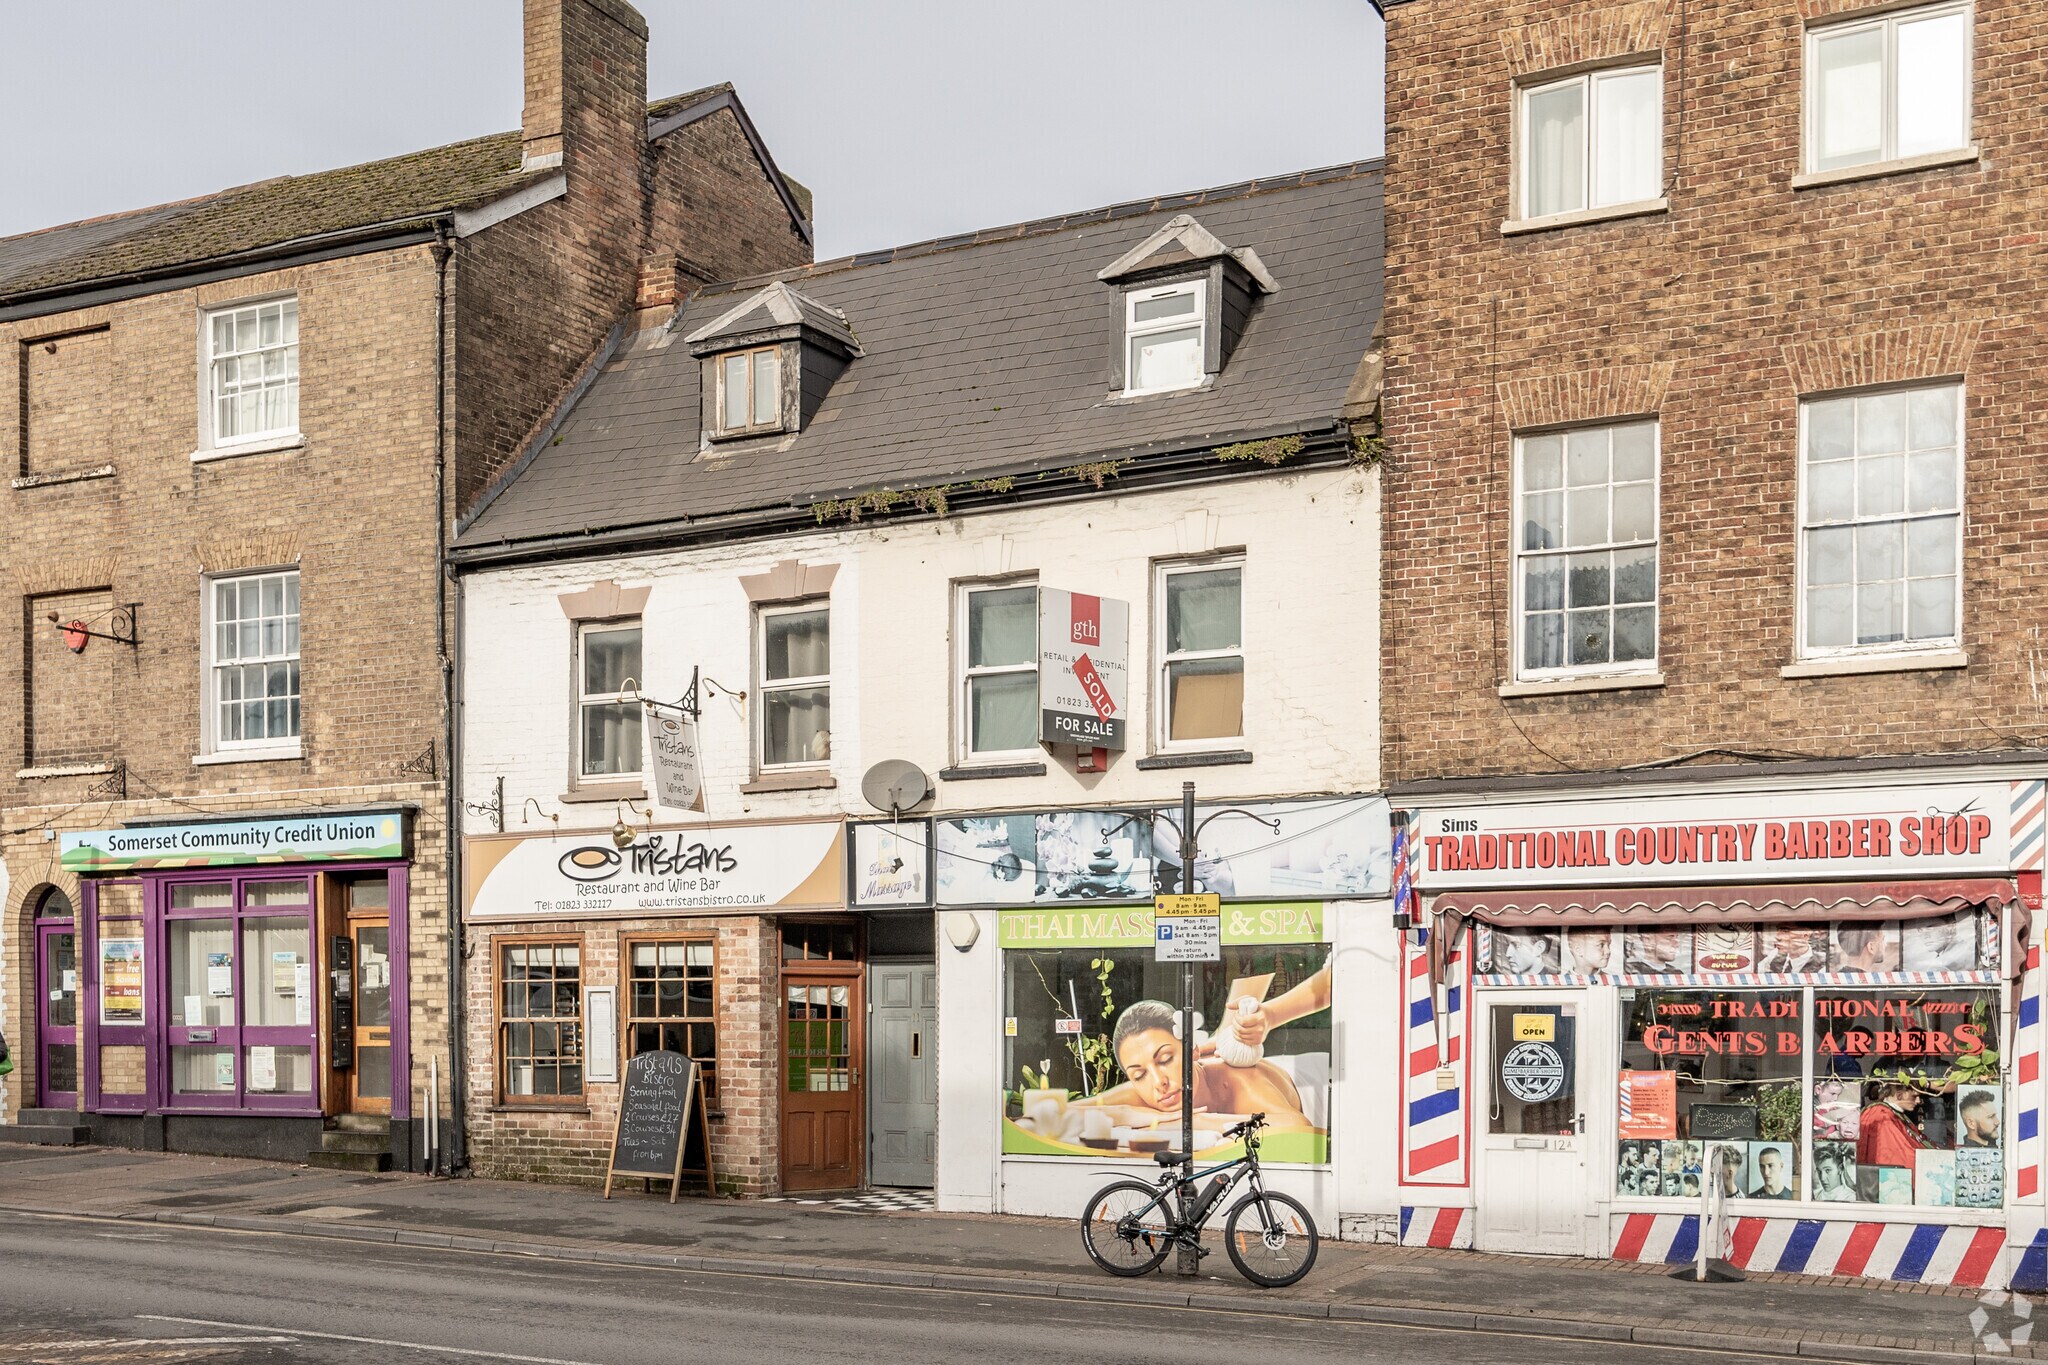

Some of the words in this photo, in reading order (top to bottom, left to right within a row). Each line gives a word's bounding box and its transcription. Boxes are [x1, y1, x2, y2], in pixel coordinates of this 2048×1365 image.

[1073, 620, 1097, 640] gth
[1044, 652, 1068, 662] RETAIL
[1056, 696, 1082, 707] 01823
[1083, 672, 1112, 717] SOLD
[1055, 716, 1080, 732] FOR
[1084, 720, 1113, 736] SALE
[653, 734, 695, 758] Tristans
[659, 756, 694, 771] Restaurant
[672, 772, 684, 781] and
[666, 782, 682, 794] Wine
[683, 786, 694, 796] Bar
[1442, 819, 1478, 833] Sims
[108, 833, 177, 851] Somerset
[181, 827, 270, 848] Community
[274, 824, 322, 843] Credit
[326, 822, 375, 840] Union
[1424, 829, 1610, 871] TRADITIONAL
[1615, 823, 1757, 866] COUNTRY
[1765, 818, 1892, 860] BARBER
[1900, 815, 1991, 856] SHOP
[618, 834, 738, 876] Tristans
[575, 882, 640, 897] Restaurant
[643, 880, 664, 893] and
[668, 878, 697, 893] Wine
[700, 878, 721, 891] Bar
[534, 901, 553, 912] Tel:
[555, 900, 581, 910] 01823
[583, 899, 612, 910] 332117
[638, 893, 766, 908] www.tristansbistro.co.uk
[1002, 914, 1075, 940] THAI
[1229, 910, 1255, 936] &
[1260, 908, 1318, 935] SPA
[1522, 1028, 1545, 1036] OPEN
[52, 1055, 63, 1063] For
[632, 1054, 682, 1075] Tristans
[52, 1078, 64, 1086] not
[641, 1071, 674, 1086] Bistro
[630, 1085, 657, 1101] Serving
[658, 1085, 677, 1099] fresh
[628, 1099, 663, 1111] Seasonal
[664, 1101, 681, 1113] food
[624, 1113, 630, 1123] 2
[631, 1113, 659, 1122] Courses
[624, 1125, 630, 1135] 3
[631, 1124, 659, 1133] Courses
[622, 1137, 639, 1146] Tues
[651, 1136, 666, 1145] Sat
[1206, 1178, 1234, 1215] VARUN
